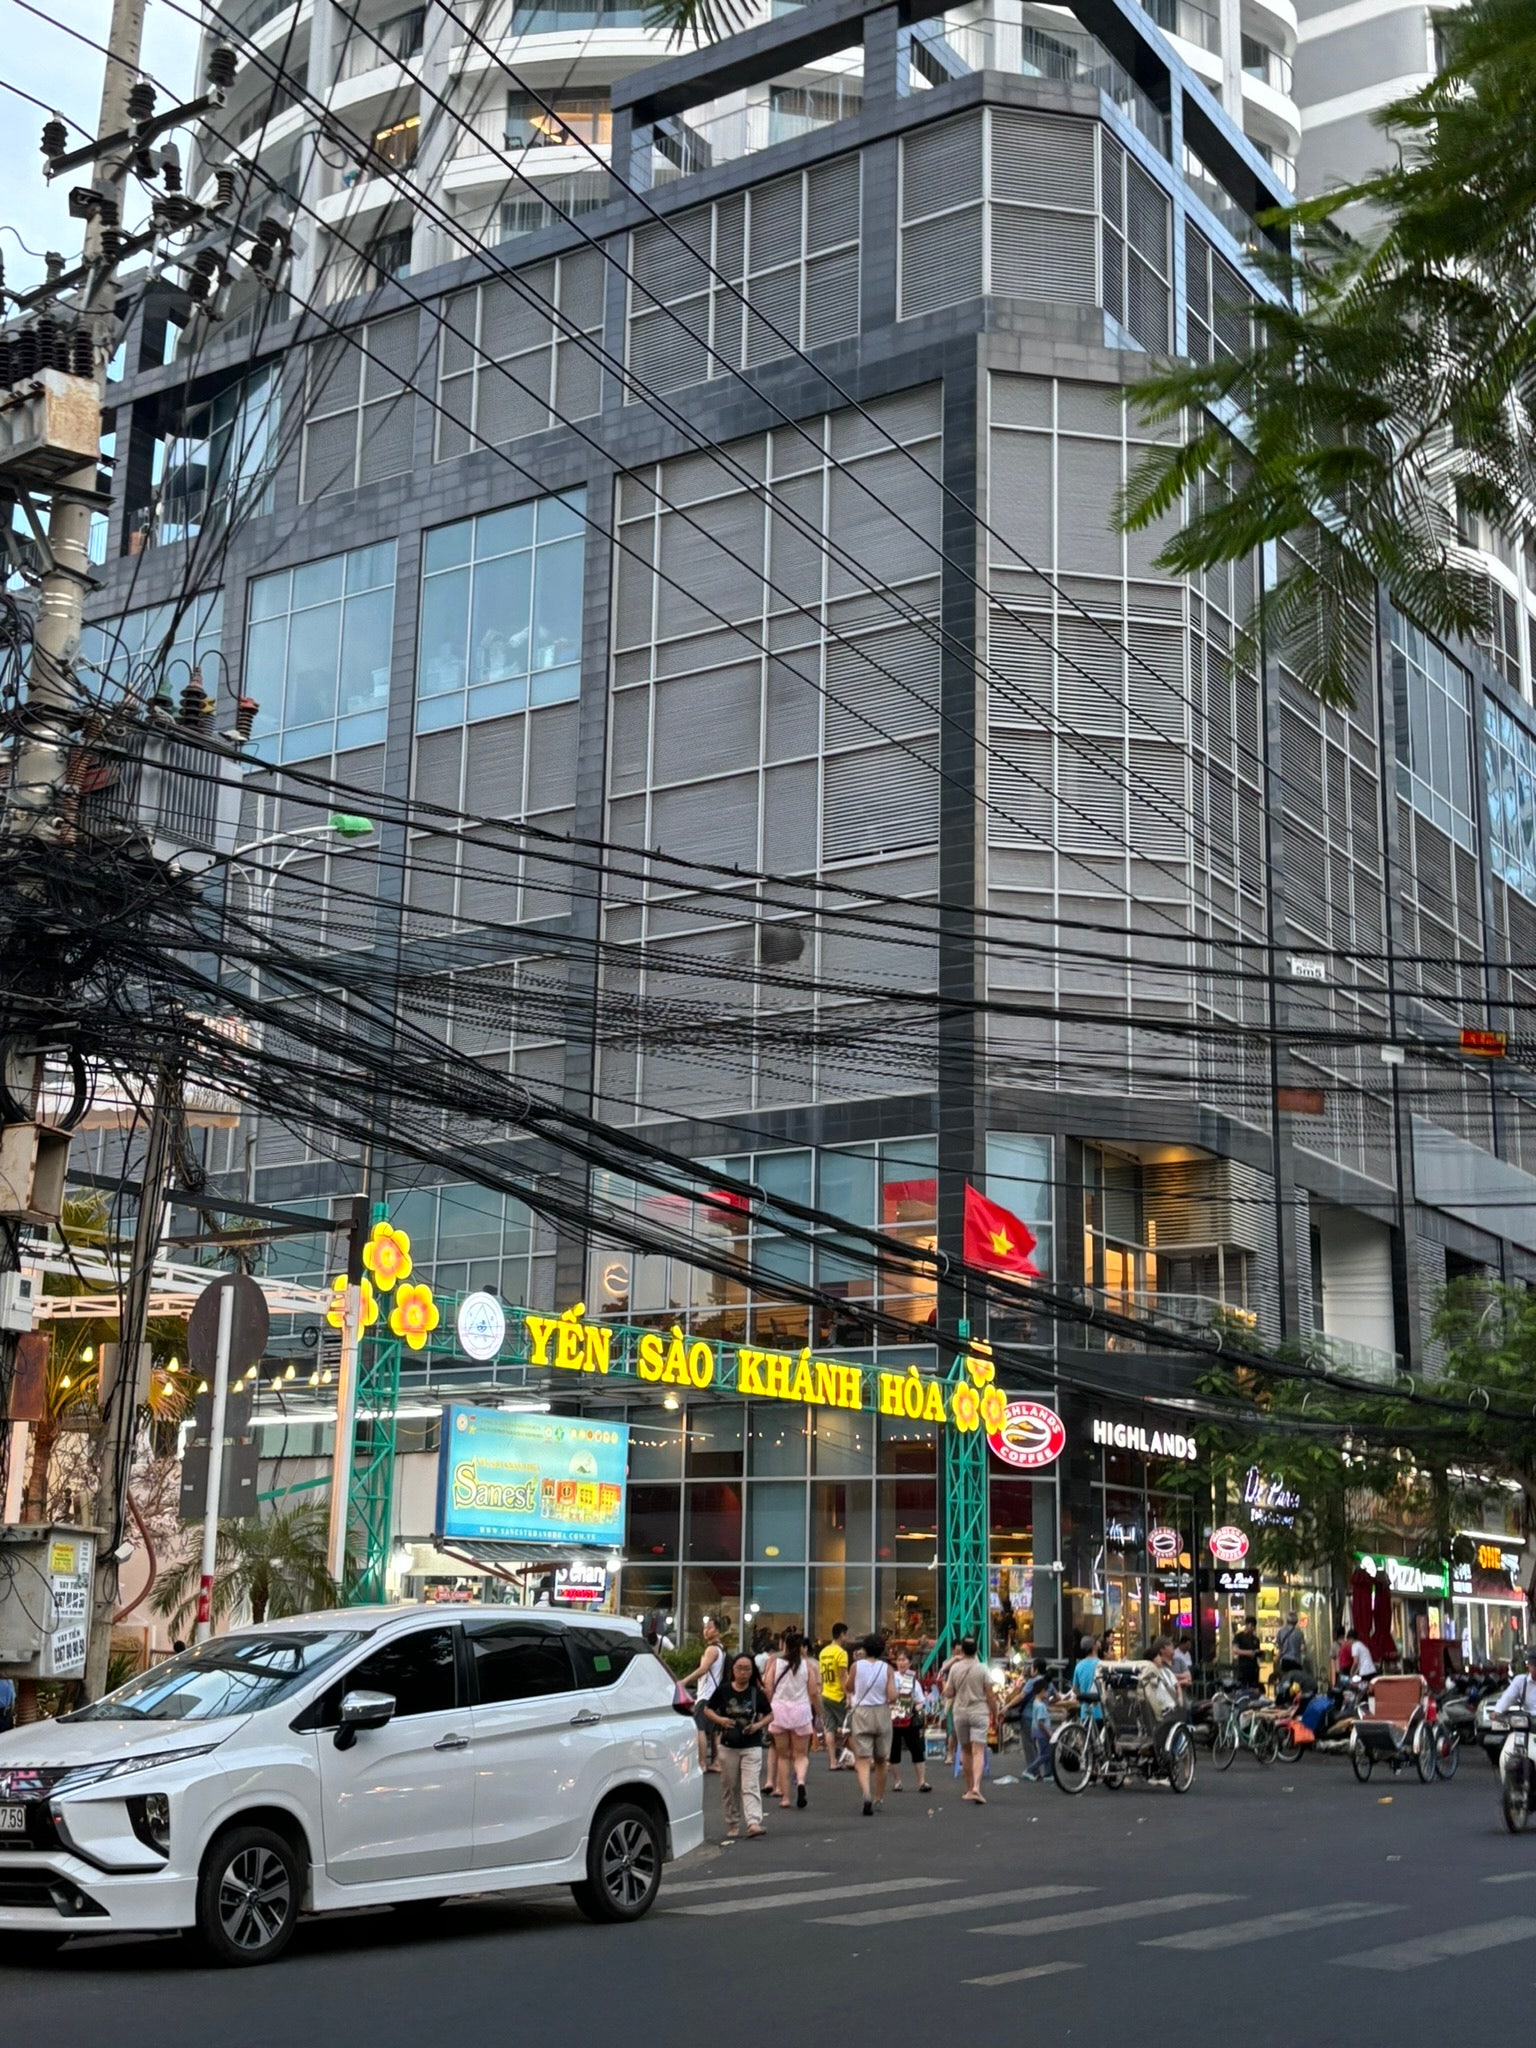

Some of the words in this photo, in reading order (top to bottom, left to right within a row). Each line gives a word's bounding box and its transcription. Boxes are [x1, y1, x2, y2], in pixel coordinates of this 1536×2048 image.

[525, 1302, 613, 1375] YẾN
[638, 1325, 714, 1389] SÀO
[738, 1347, 862, 1410] KHÁNH
[880, 1365, 947, 1423] HÒA
[1004, 1400, 1062, 1434] GHLANDS
[1000, 1446, 1054, 1464] COFFEE
[1093, 1419, 1198, 1461] HIGHLANDS
[454, 1462, 537, 1511] Sanest
[1, 1808, 23, 1828] 7.59
